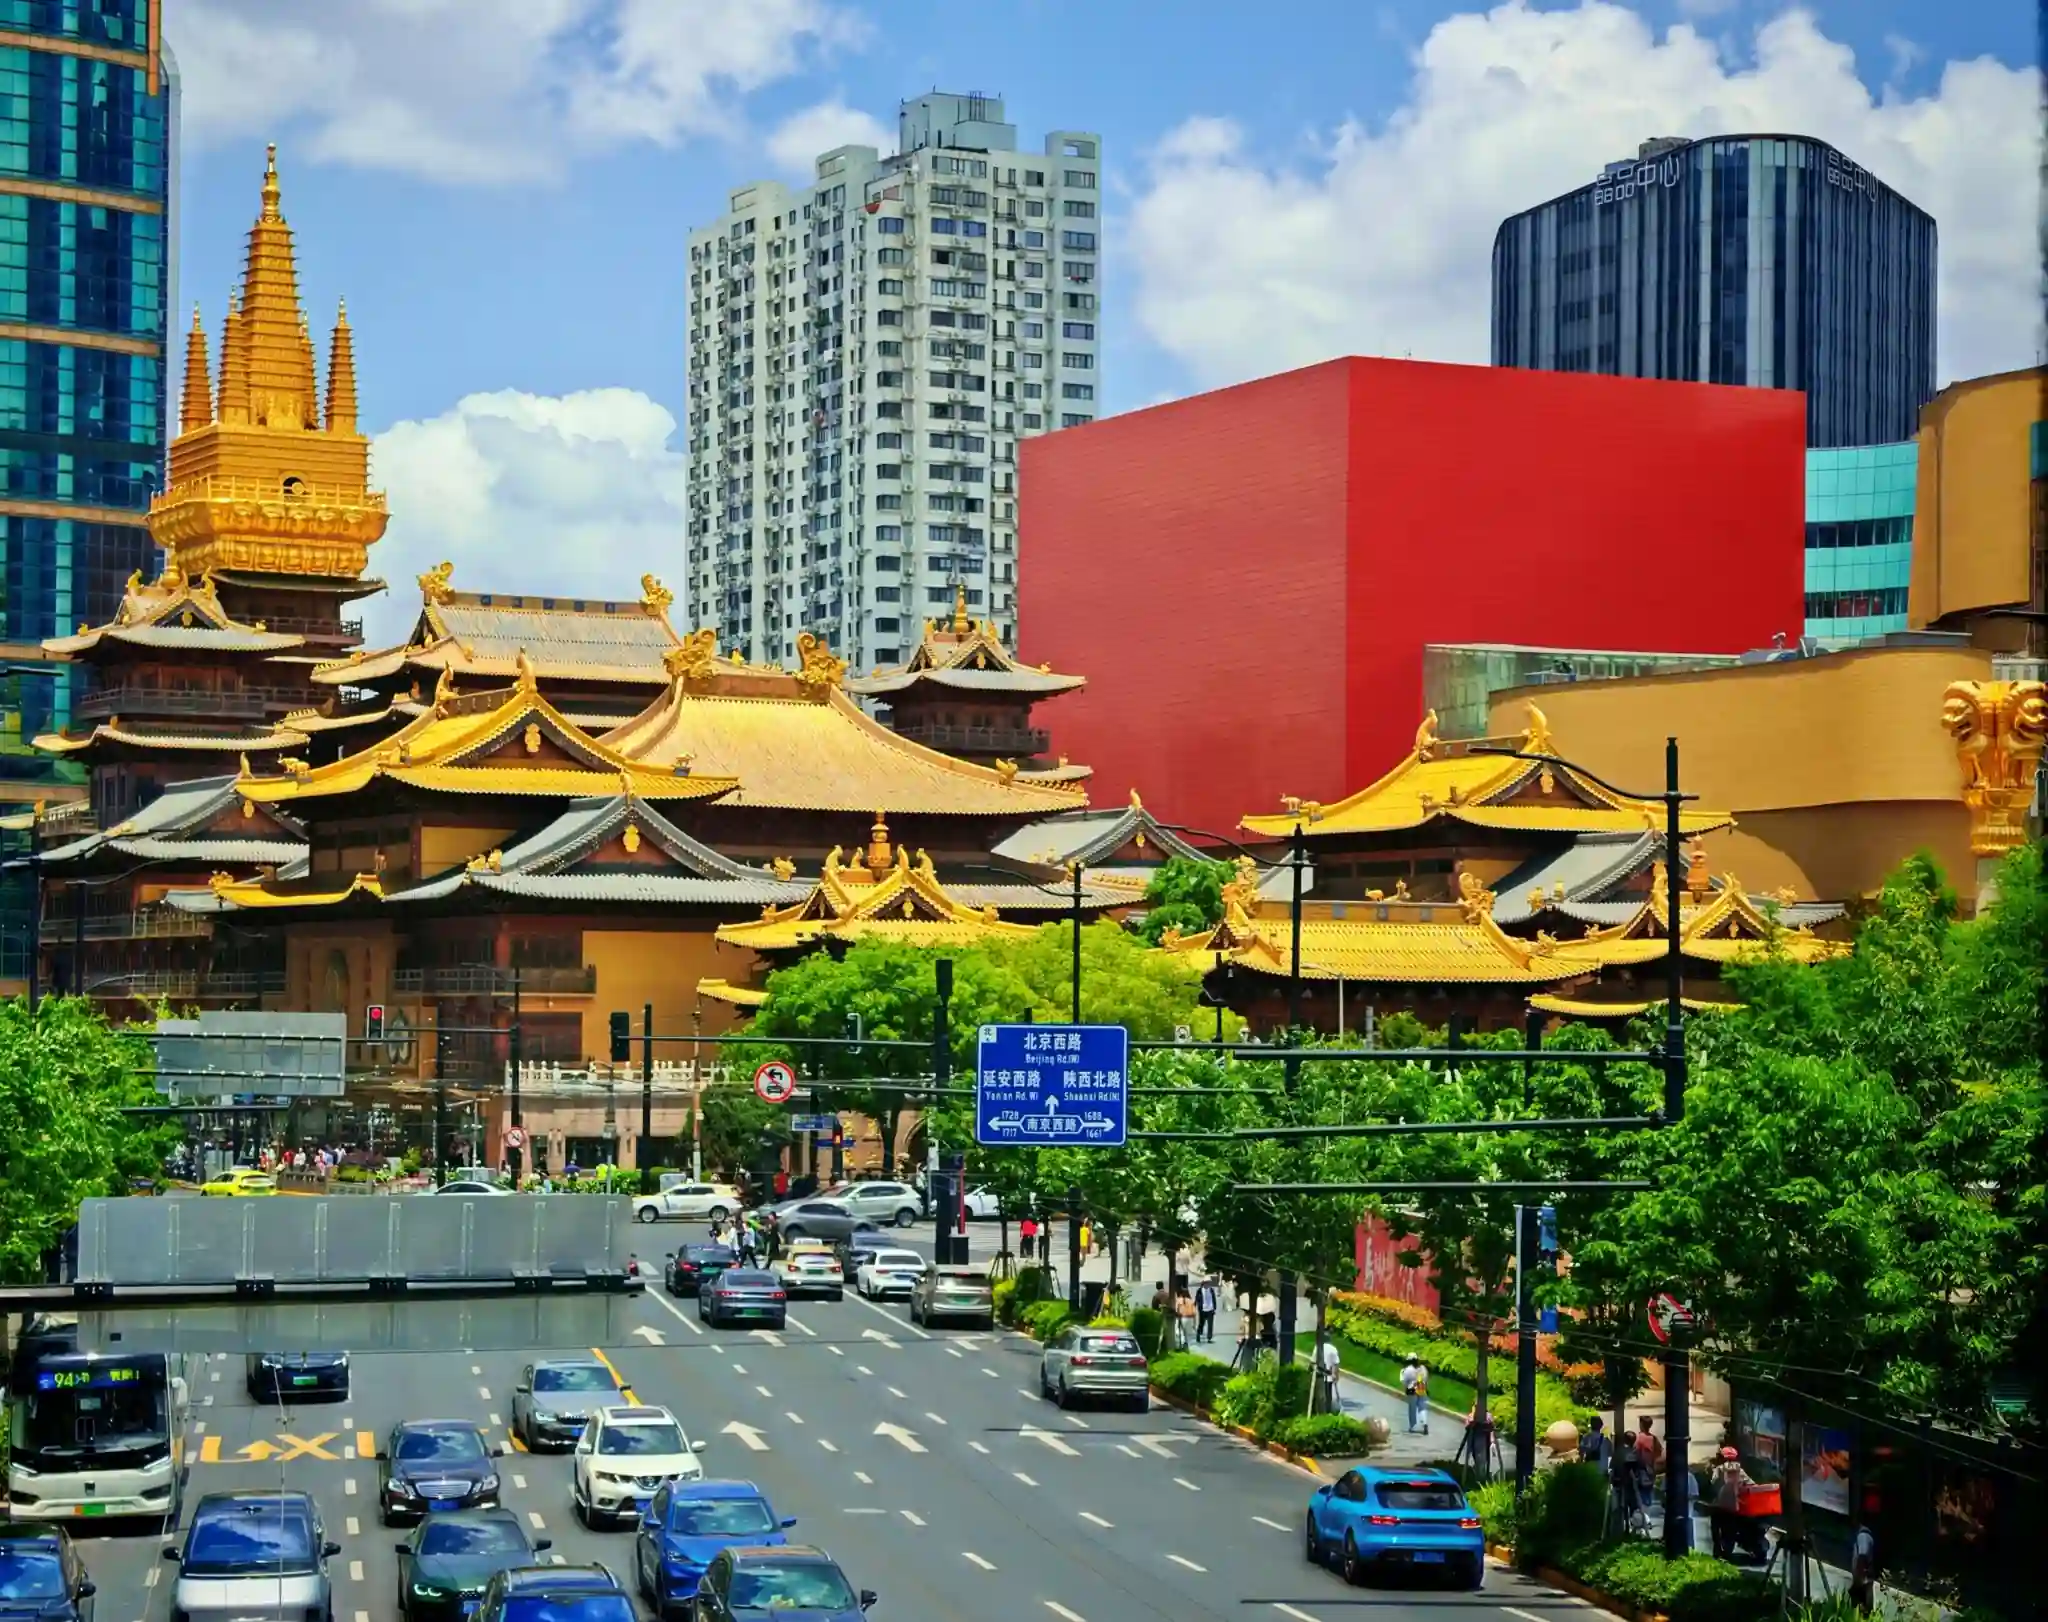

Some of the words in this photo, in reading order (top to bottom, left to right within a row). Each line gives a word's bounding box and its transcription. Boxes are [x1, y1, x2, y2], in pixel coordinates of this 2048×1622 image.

[1023, 1032, 1082, 1050] 北京西路
[1025, 1054, 1055, 1066] Beijing
[983, 1070, 1041, 1088] 延安西路
[1063, 1070, 1121, 1088] 陕西北路
[1002, 1128, 1017, 1137] 1717
[1027, 1118, 1077, 1132] 南京西路
